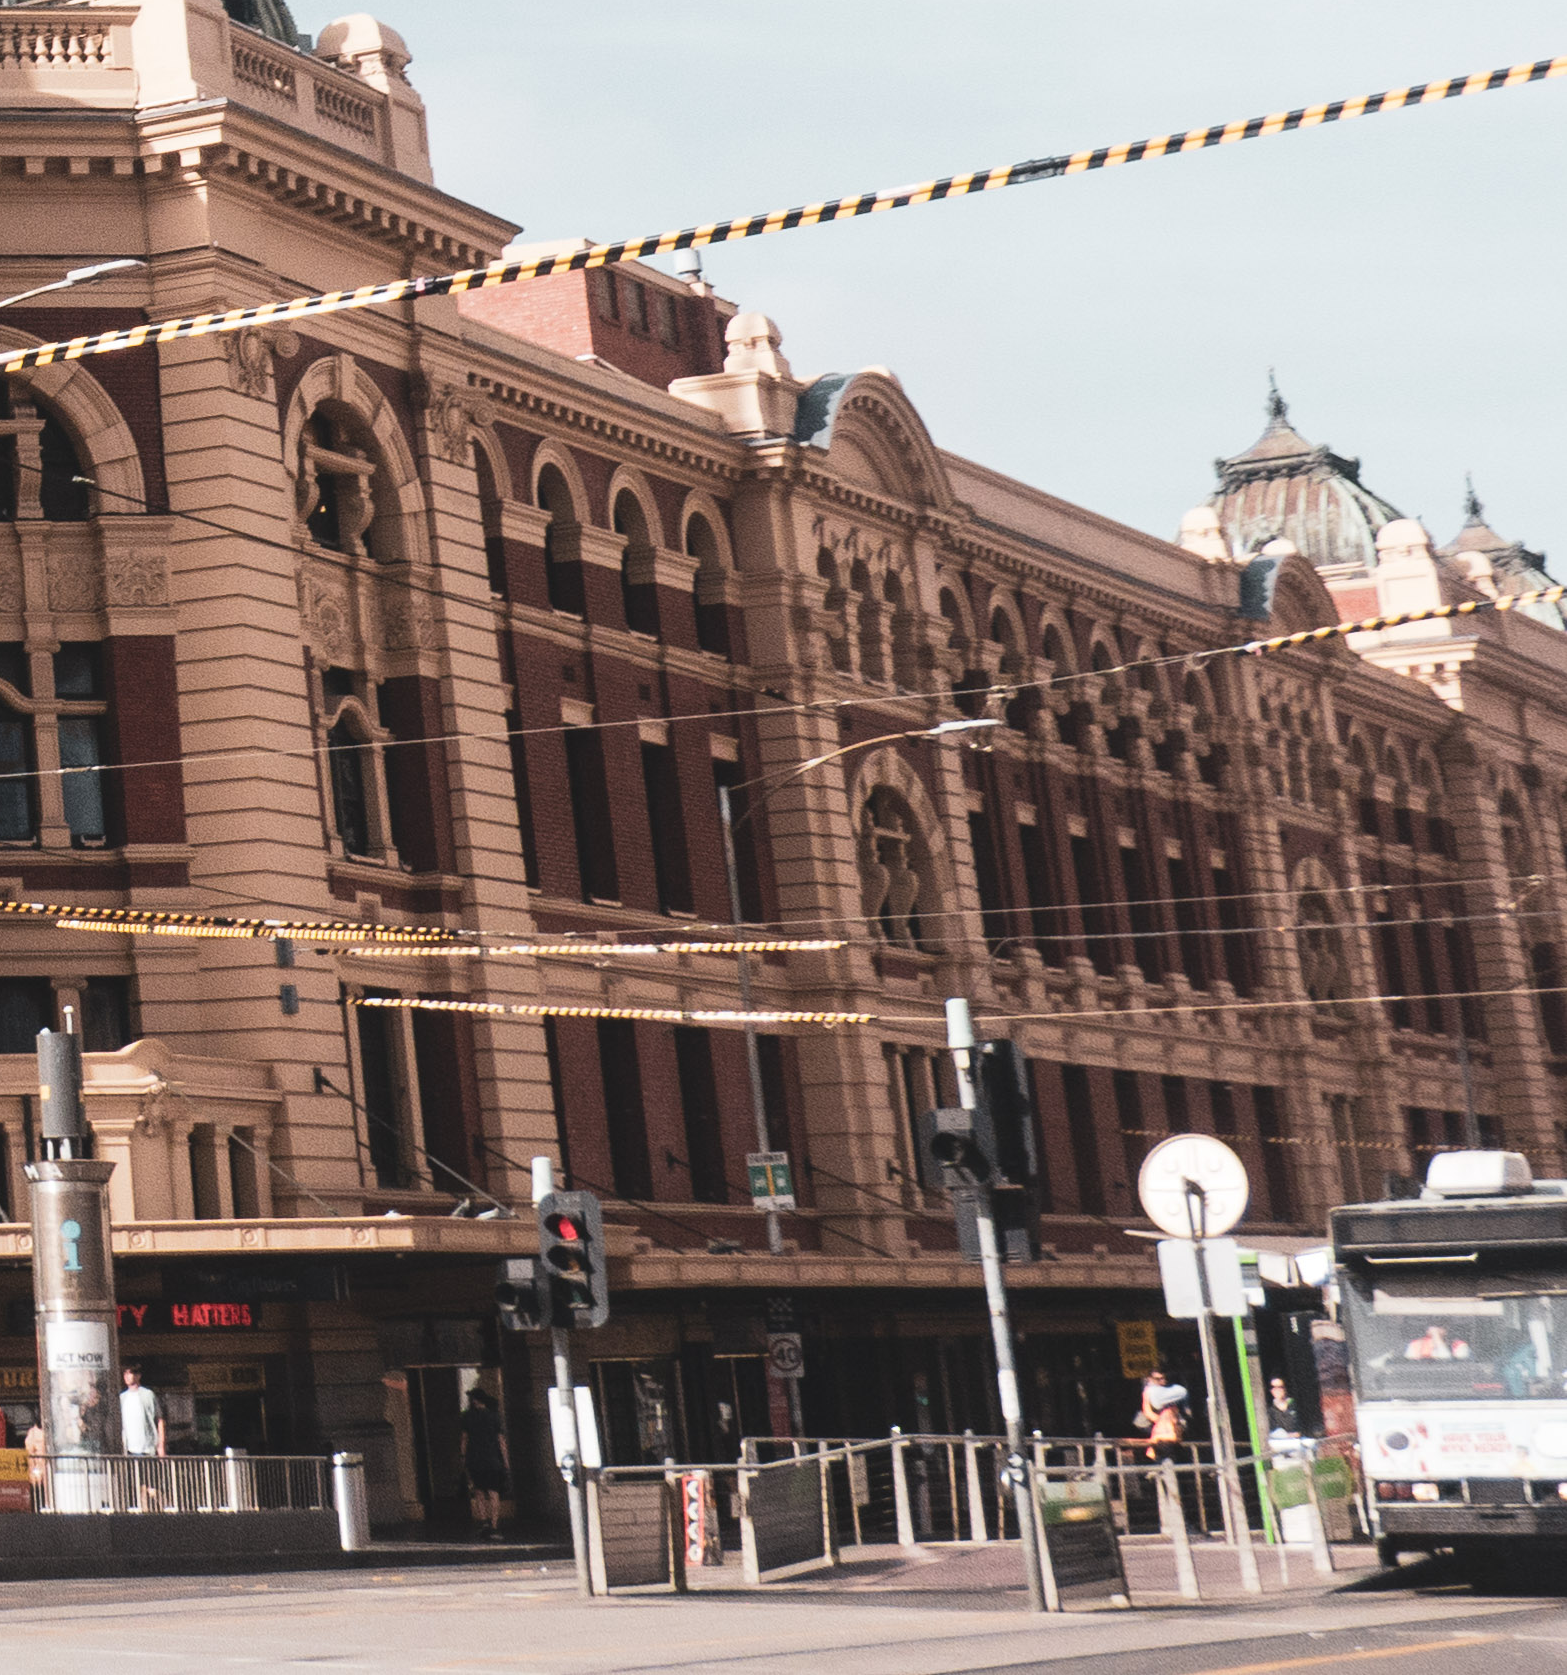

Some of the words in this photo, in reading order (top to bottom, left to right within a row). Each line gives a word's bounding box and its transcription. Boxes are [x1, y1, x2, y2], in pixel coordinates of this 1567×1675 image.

[171, 1302, 253, 1326] HATTERS
[56, 1352, 74, 1363] ACT
[77, 1352, 104, 1363] NOW
